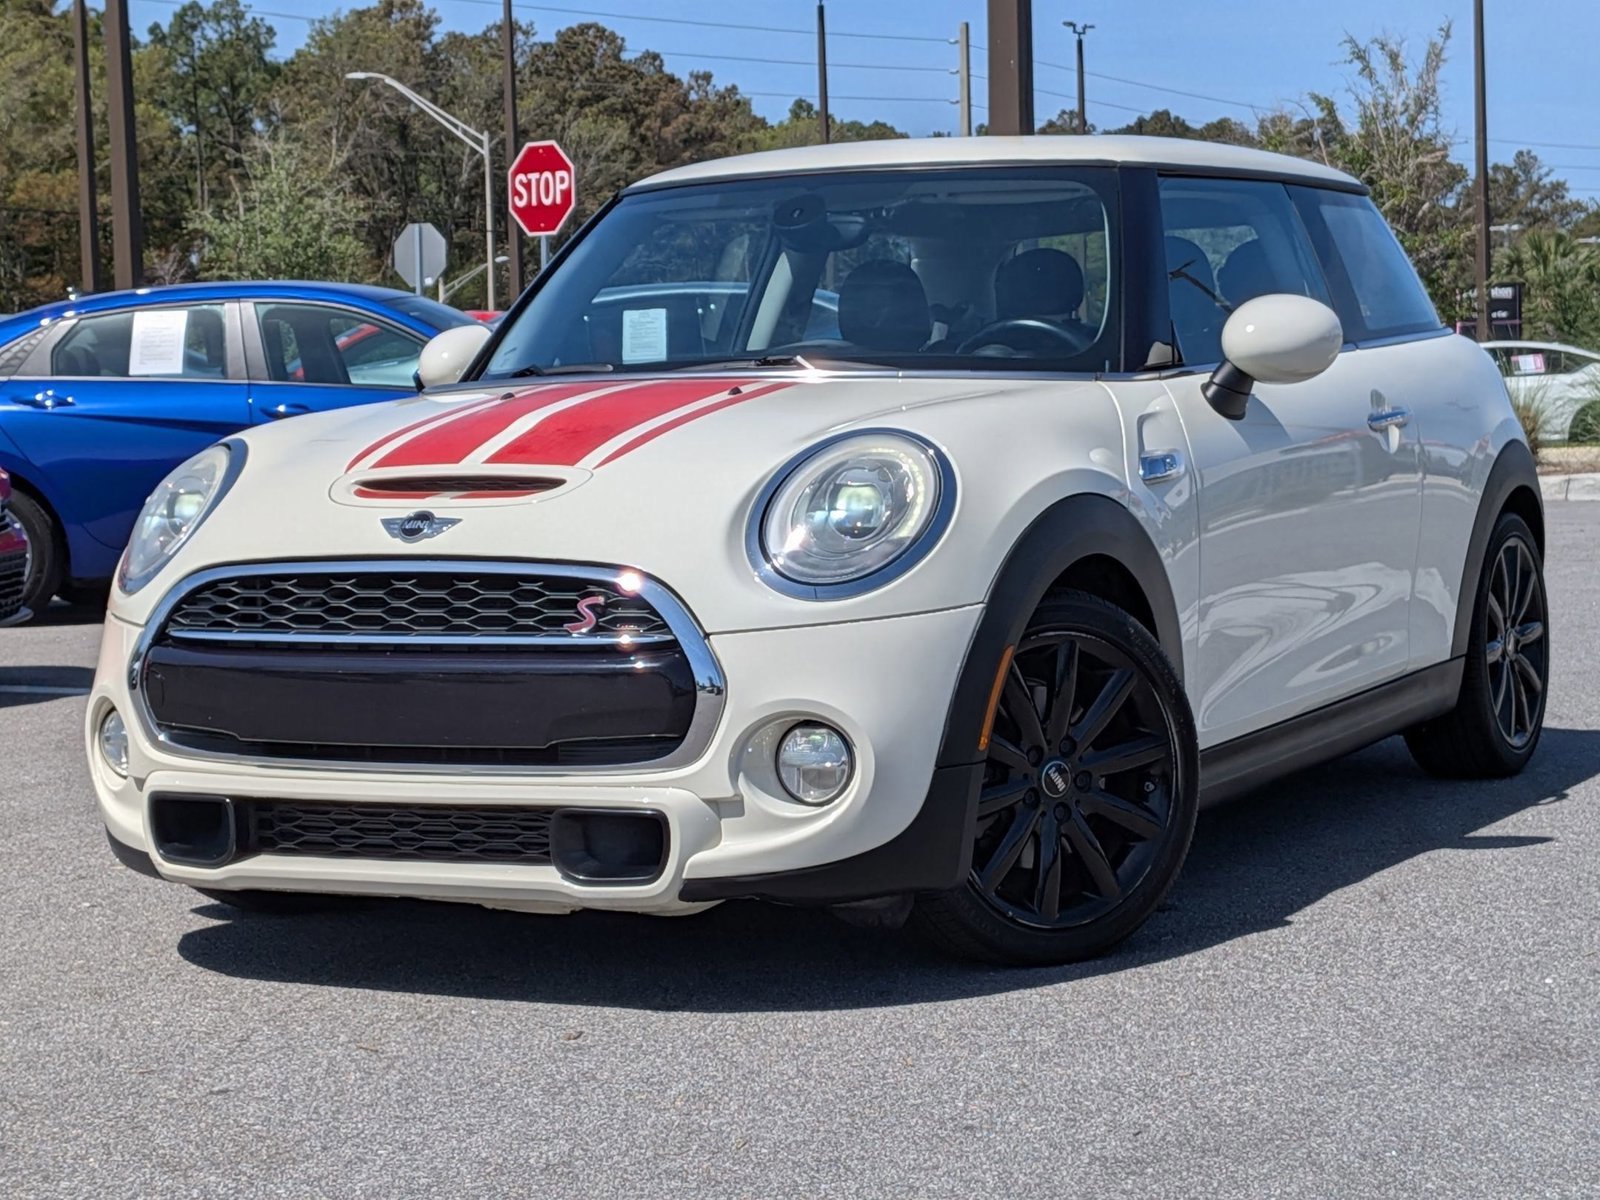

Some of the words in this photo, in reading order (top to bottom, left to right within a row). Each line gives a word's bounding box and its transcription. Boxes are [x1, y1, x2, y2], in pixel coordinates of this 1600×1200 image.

[514, 170, 570, 208] STOP
[402, 519, 430, 529] MINI
[563, 596, 605, 633] S
[1048, 766, 1066, 792] MINI
